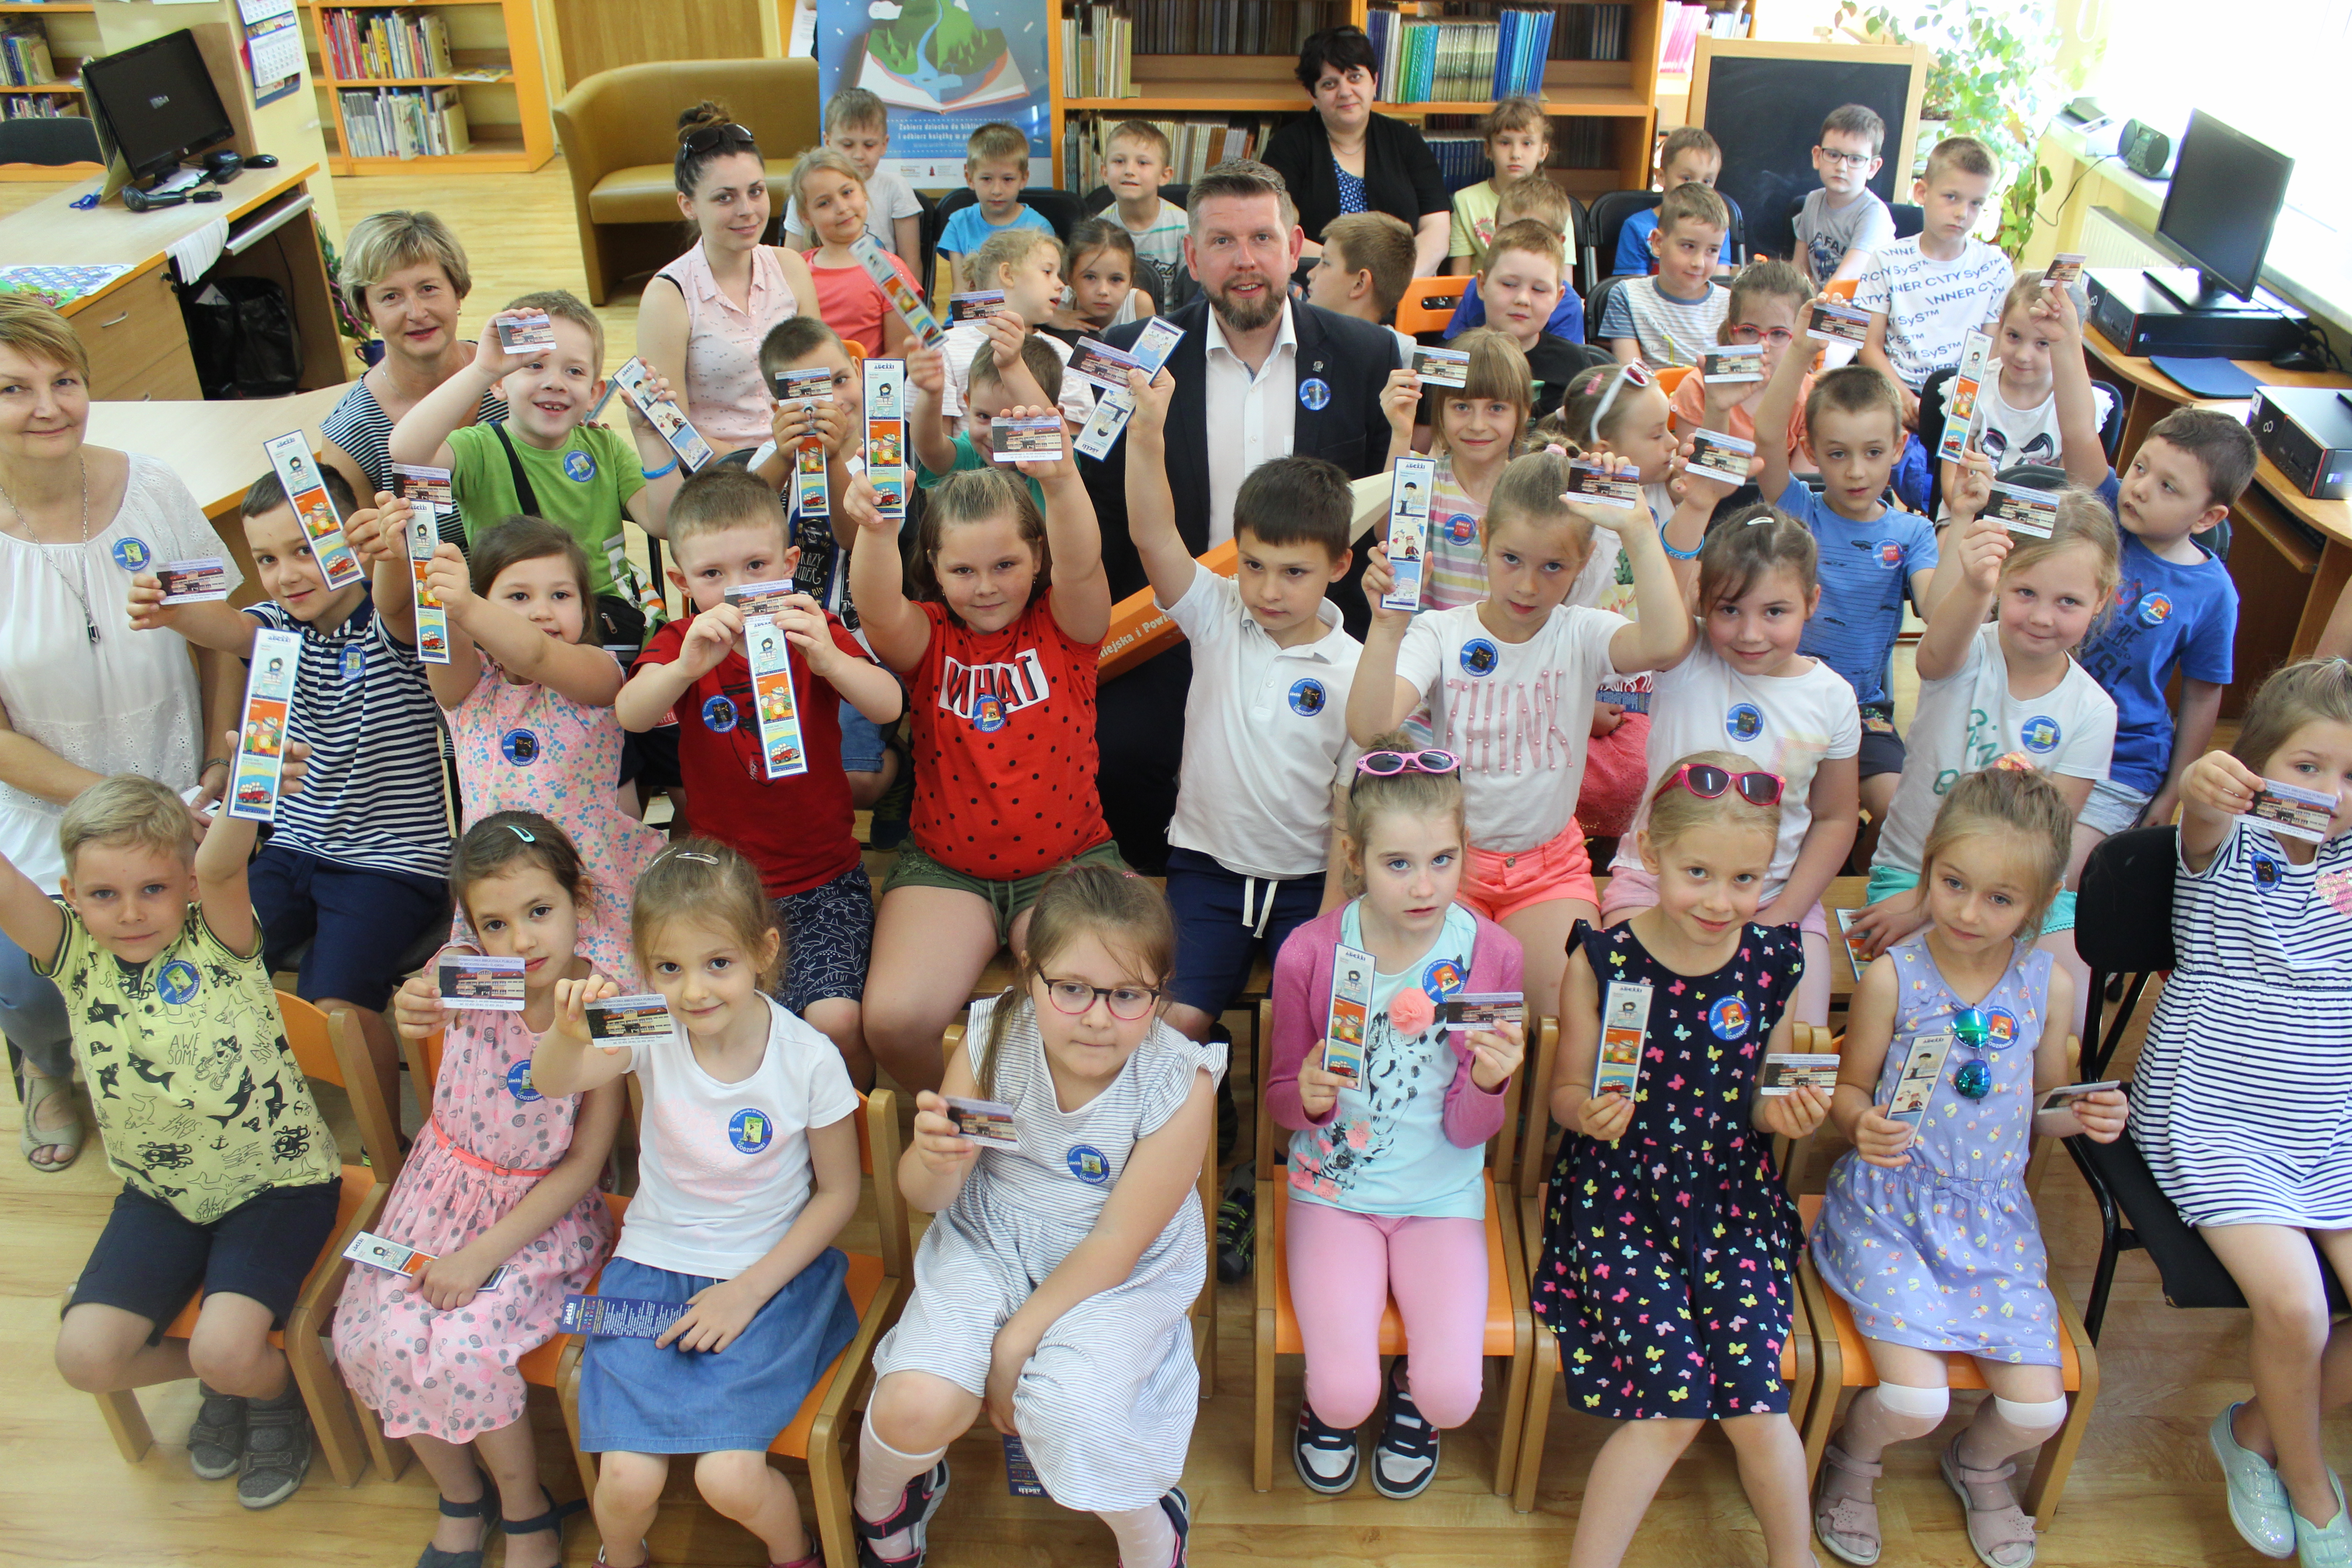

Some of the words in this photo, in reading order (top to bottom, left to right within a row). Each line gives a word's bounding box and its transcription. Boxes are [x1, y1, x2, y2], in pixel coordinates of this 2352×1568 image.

[2254, 398, 2259, 407] 2
[801, 552, 824, 568] RAZY
[1669, 551, 1686, 559] CCC
[1135, 627, 1142, 637] i
[1463, 664, 1488, 676] CODZIENNIE!
[948, 655, 1038, 716] WHAT
[1293, 706, 1318, 715] CODZIENNIE!
[714, 718, 736, 732] CODZIENNIE!
[982, 717, 1004, 731] CODZIENNIE!
[1446, 670, 1573, 774] THINK
[510, 756, 536, 765] CODZIENNIE!
[176, 980, 199, 1003] CODZIENNIE!
[1725, 1020, 1750, 1039] CODZIENNIE!
[171, 1033, 201, 1050] AWE
[167, 1049, 197, 1066] SOME
[510, 1065, 519, 1073] Czytaj
[732, 1113, 740, 1122] Czytaj
[756, 1110, 765, 1119] minut
[736, 1142, 766, 1152] CODZIENNIE!
[1079, 1174, 1106, 1183] CODZIENNIE!
